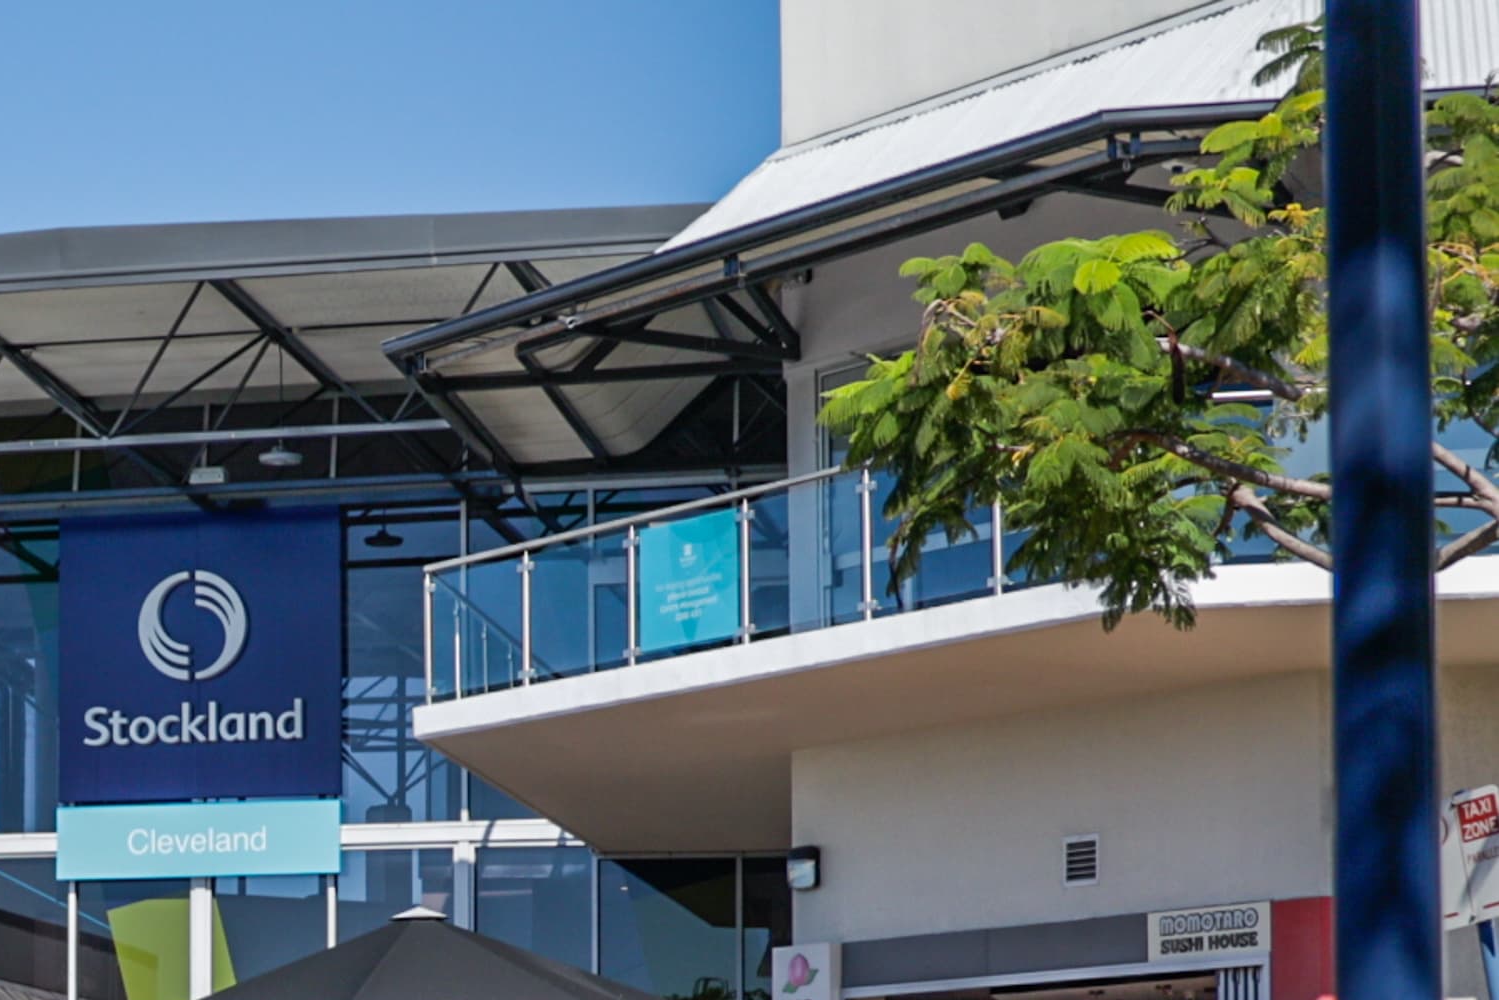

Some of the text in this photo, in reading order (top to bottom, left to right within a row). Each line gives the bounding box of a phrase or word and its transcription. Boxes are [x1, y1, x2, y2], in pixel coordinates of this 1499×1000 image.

[83, 698, 304, 747] Stockland
[1462, 797, 1494, 819] TAXI
[127, 825, 267, 855] Cleveland
[1463, 817, 1499, 840] ZONE
[1160, 931, 1258, 955] SUSHI HOUSE
